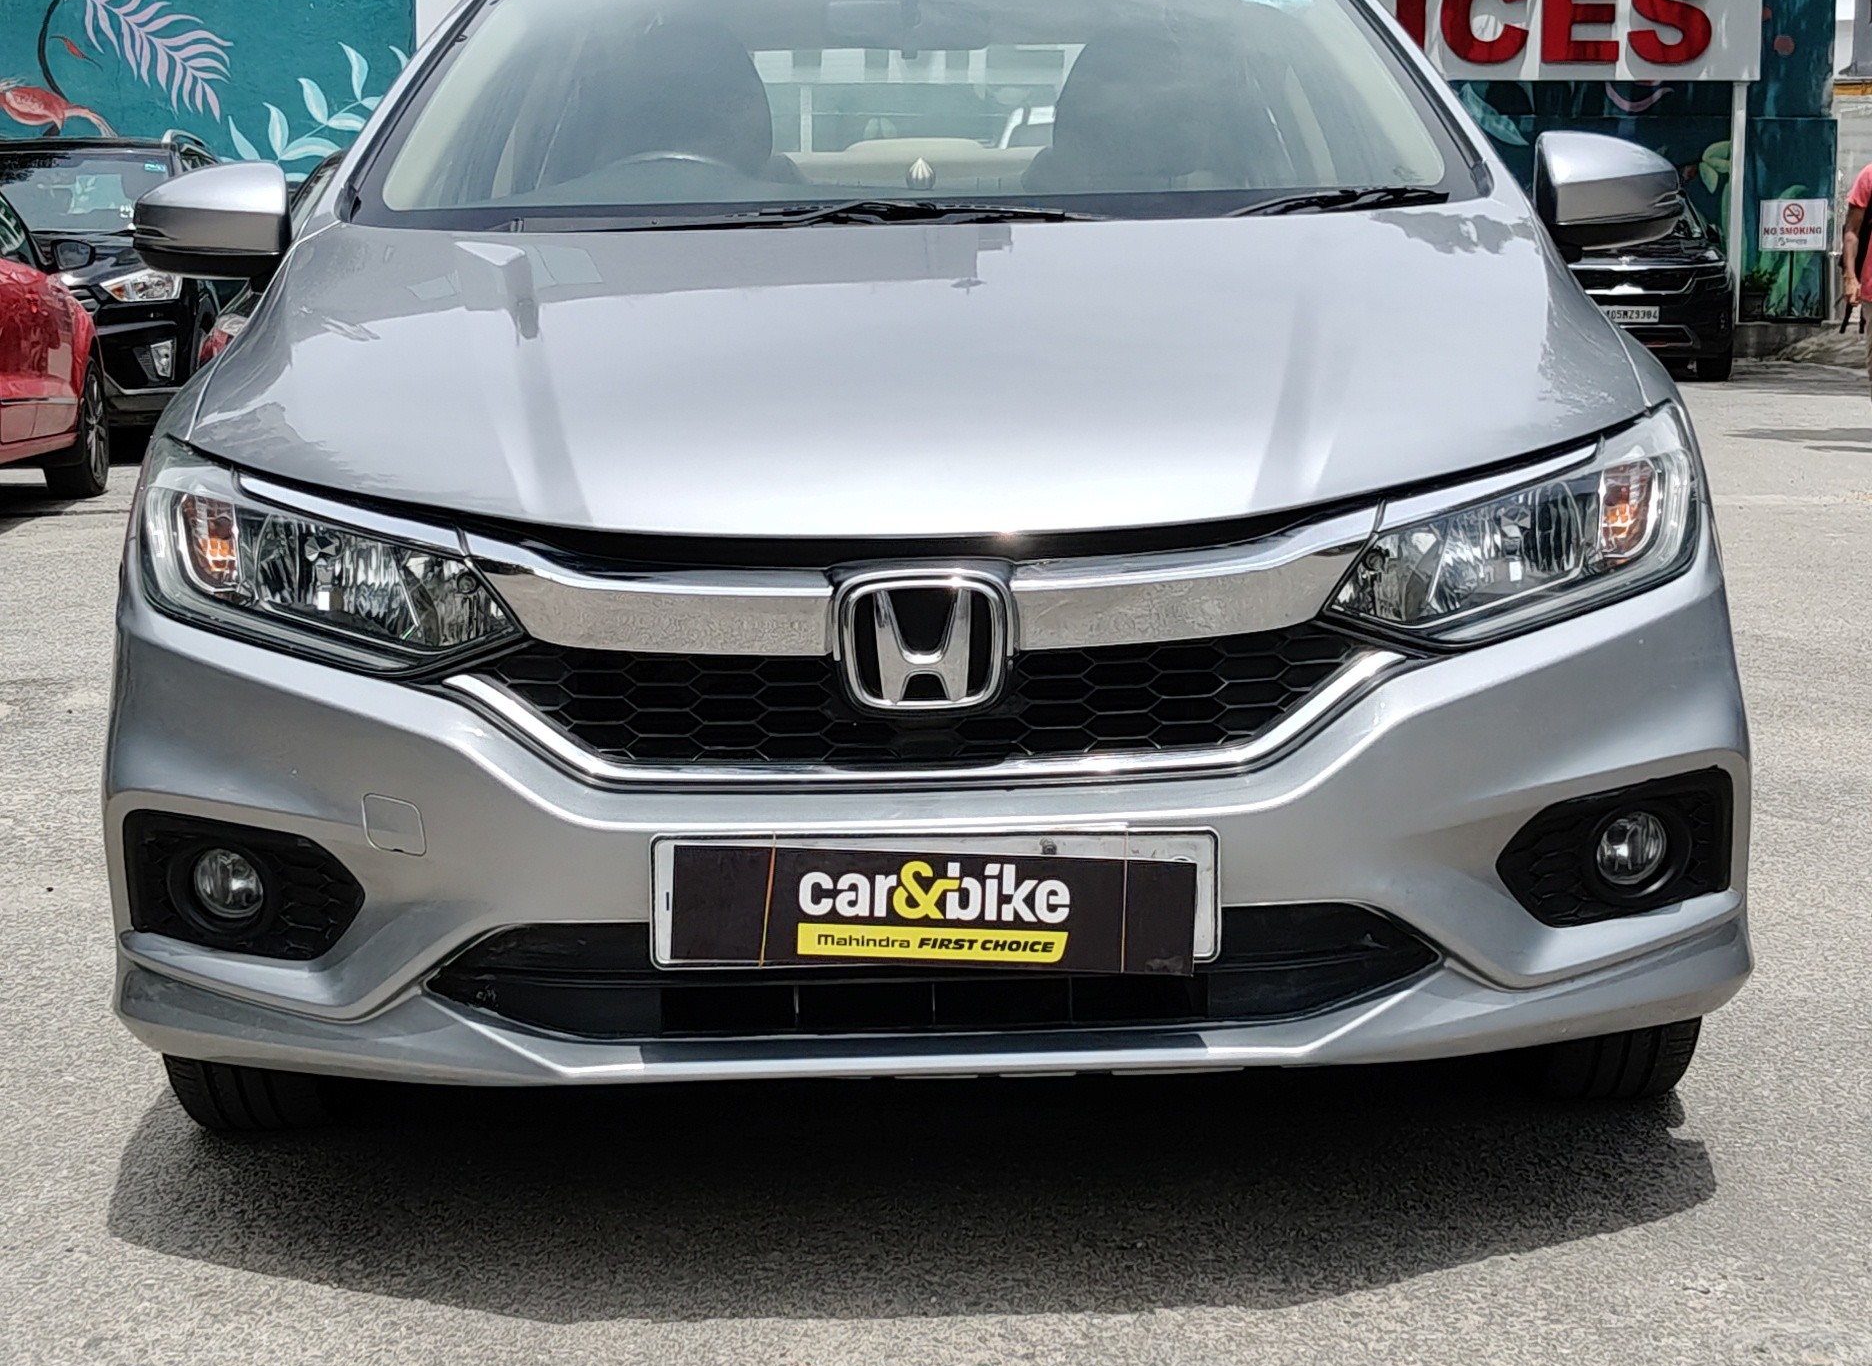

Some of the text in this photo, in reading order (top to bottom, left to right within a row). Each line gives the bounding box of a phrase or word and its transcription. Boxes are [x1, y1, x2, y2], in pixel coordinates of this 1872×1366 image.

[1763, 226, 1822, 235] NO SMOKING
[798, 860, 1071, 924] car&bike
[918, 937, 977, 952] FIRST
[980, 939, 1055, 954] CHOICE
